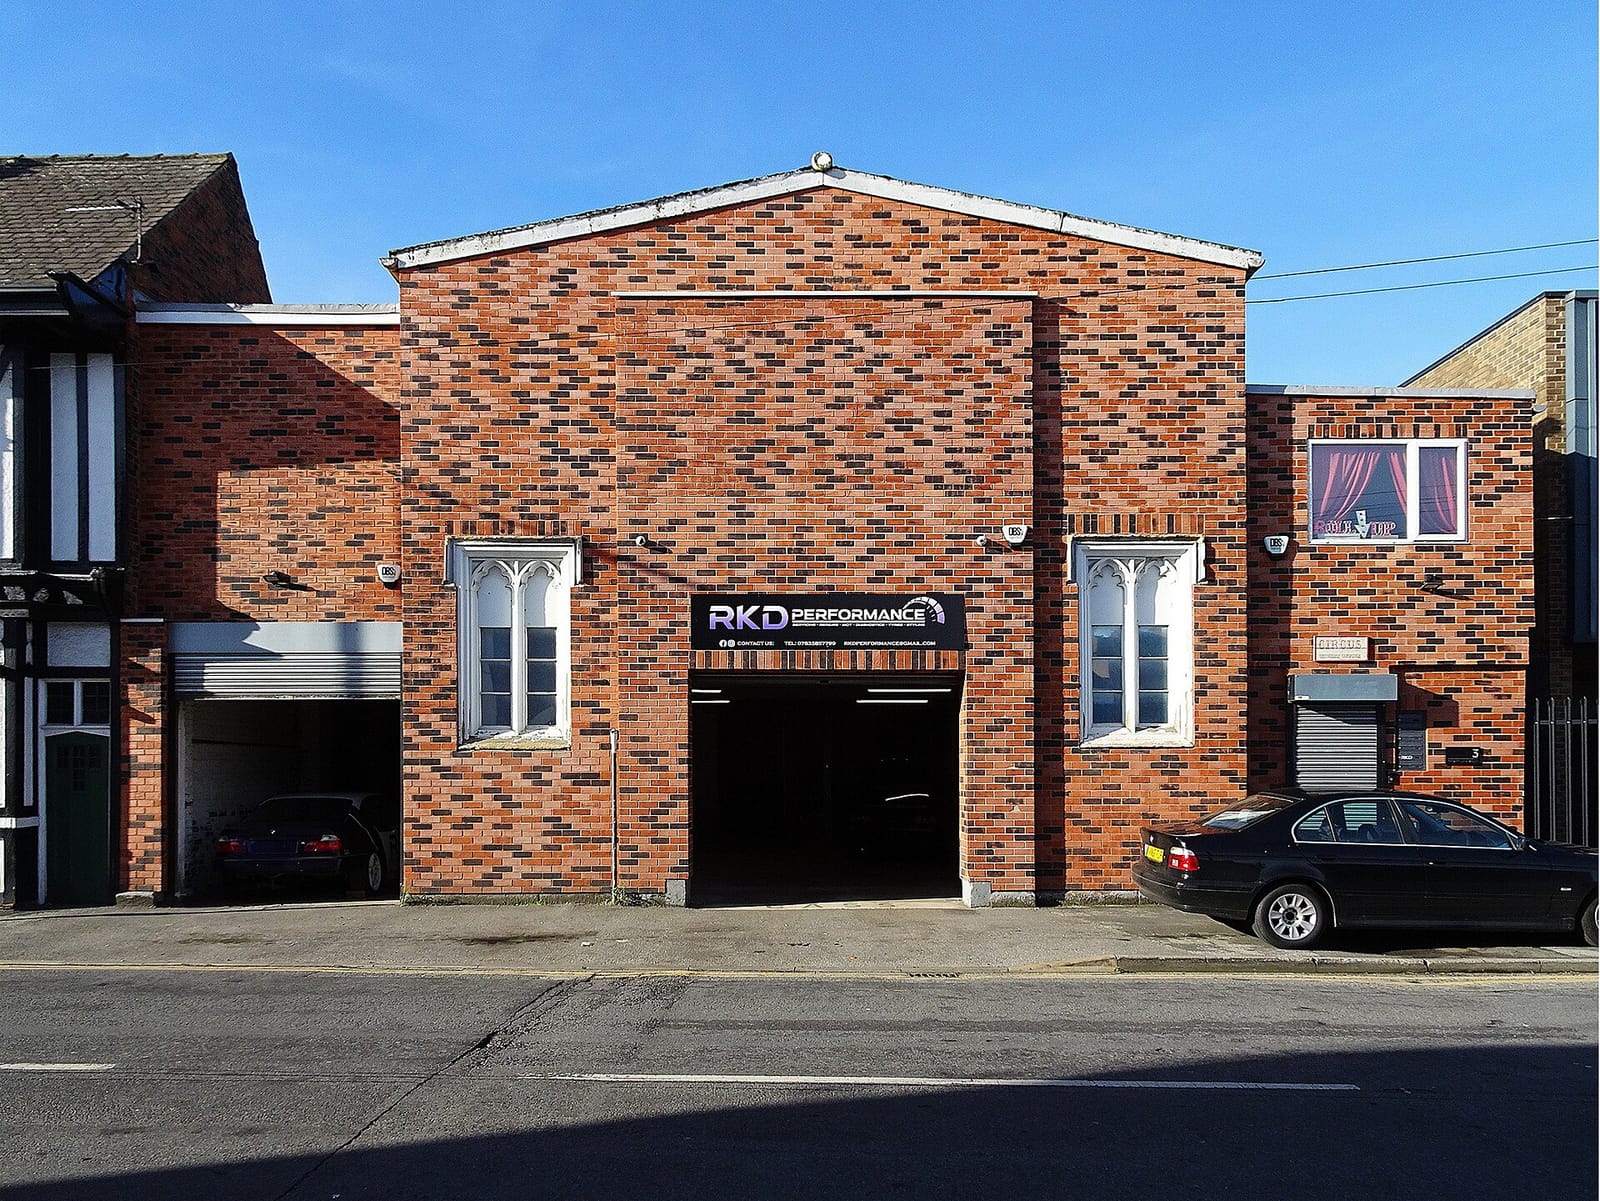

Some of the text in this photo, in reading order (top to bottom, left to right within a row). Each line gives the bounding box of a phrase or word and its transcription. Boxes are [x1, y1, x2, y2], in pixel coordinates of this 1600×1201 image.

[709, 605, 926, 630] RKD PERFORMANCE
[1319, 639, 1362, 650] CIRCUS
[1471, 748, 1480, 759] 3
